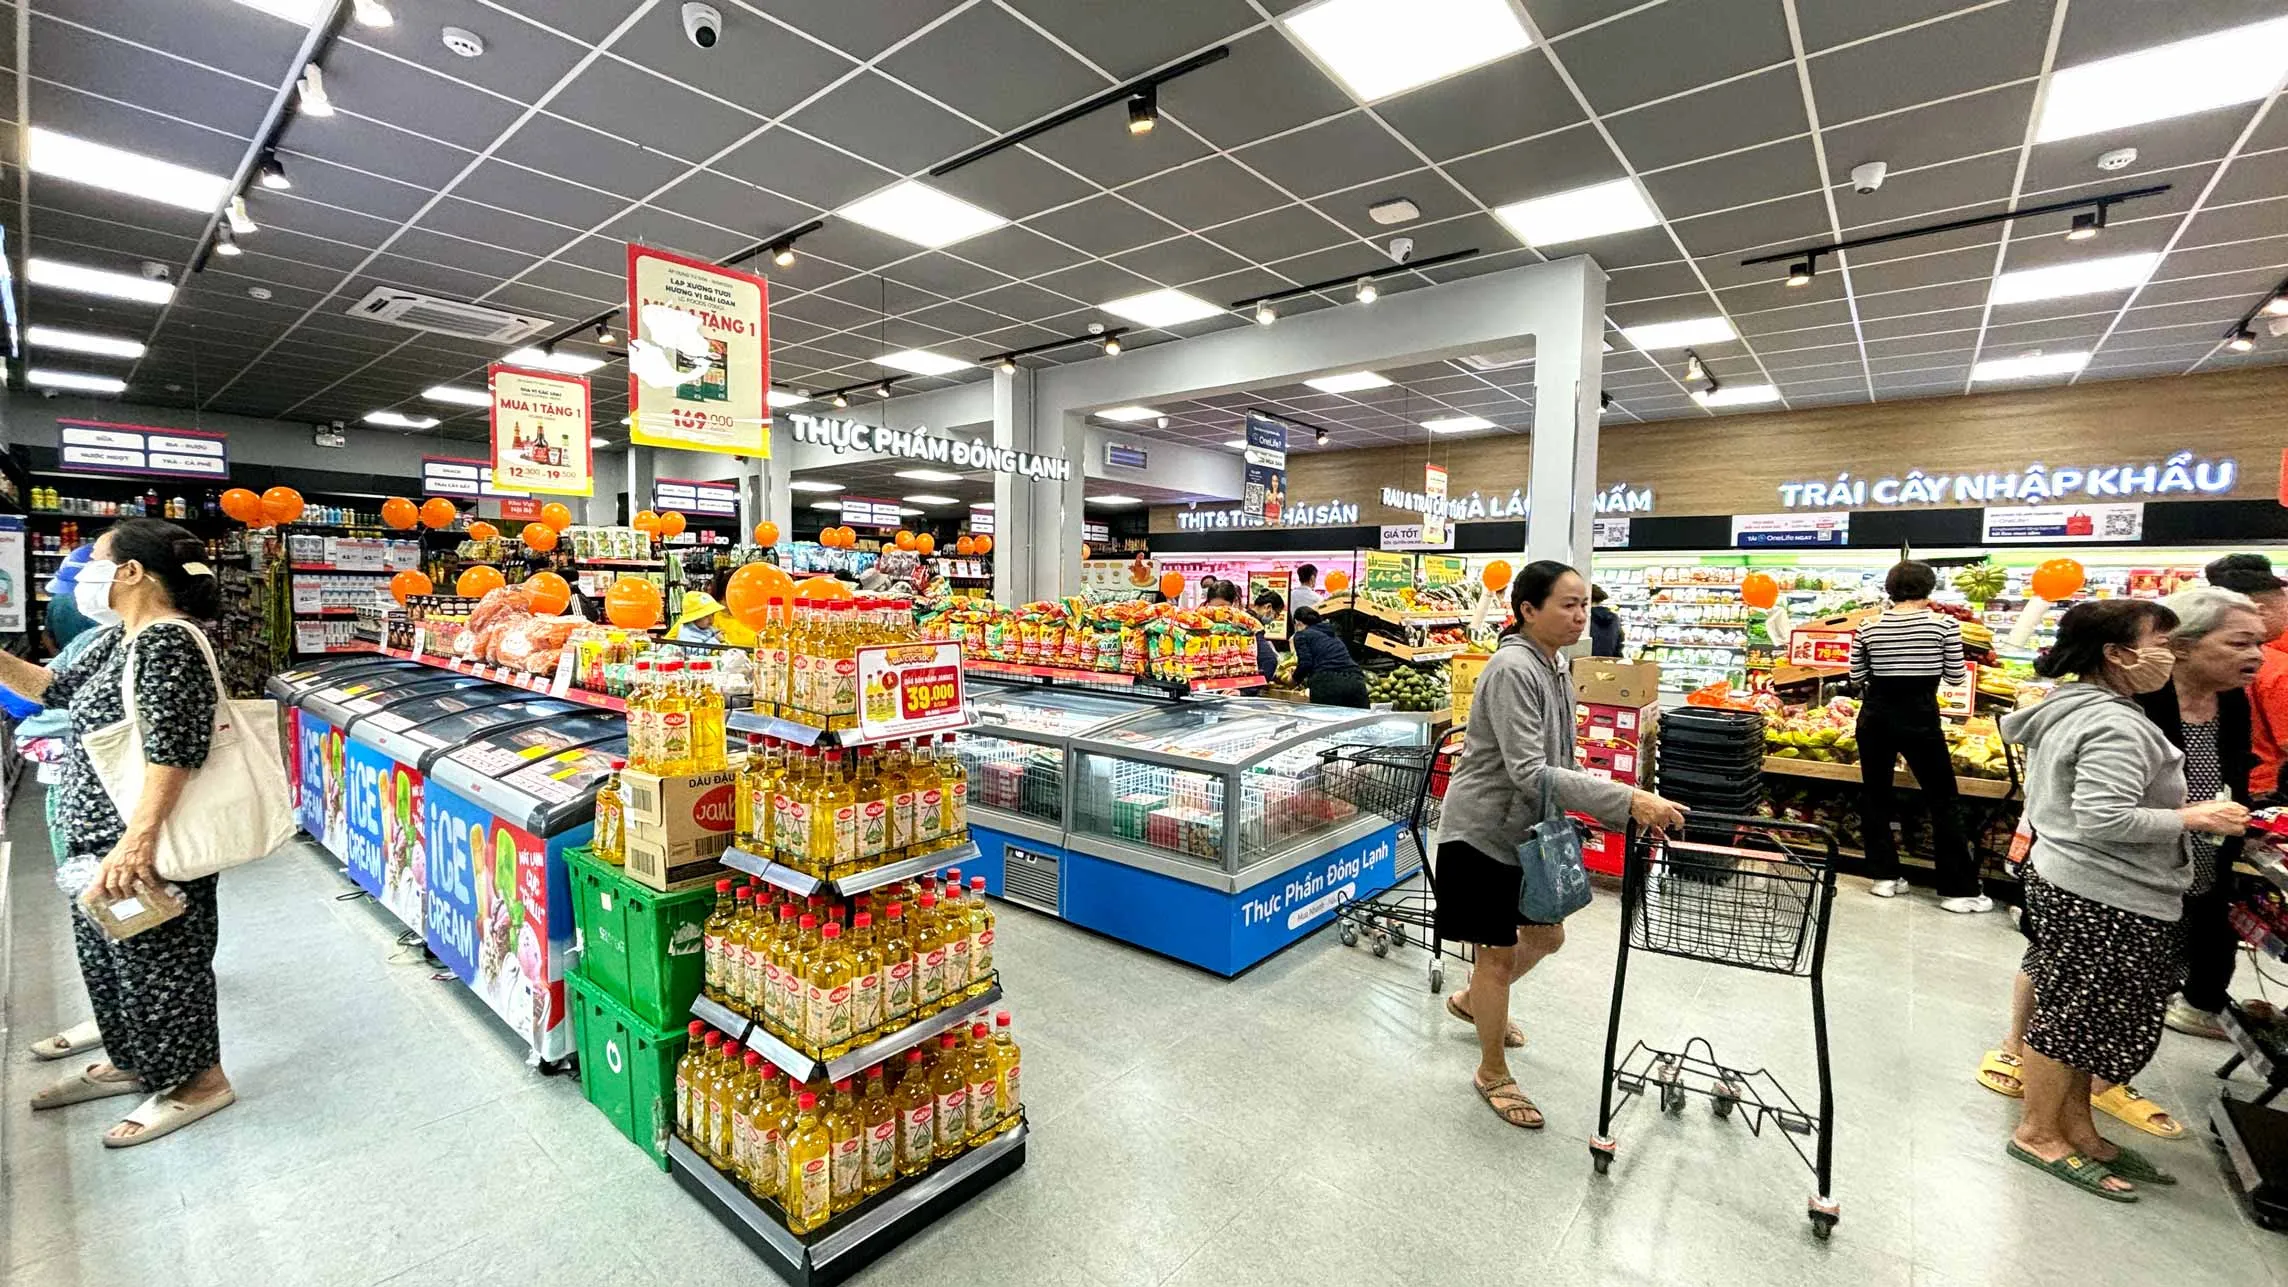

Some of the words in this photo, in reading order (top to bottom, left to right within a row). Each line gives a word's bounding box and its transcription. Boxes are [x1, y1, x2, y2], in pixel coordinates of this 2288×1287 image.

[700, 310, 745, 334] TẶNG
[749, 322, 755, 336] 1
[500, 399, 529, 411] MUA
[533, 403, 538, 412] 1
[540, 403, 573, 416] TẶNG
[576, 409, 581, 418] 1
[788, 412, 872, 453] THỰC
[873, 425, 950, 463] PHẨM
[950, 438, 1016, 474] ĐÔNG
[1016, 451, 1073, 482] LẠNH
[1382, 487, 1404, 508] RAU
[1778, 472, 1865, 508] TRÁI
[1872, 471, 1950, 505] CÂY
[1953, 463, 2084, 504] NHẬP
[2086, 452, 2236, 496] KHẨU
[1177, 510, 1216, 532] THỊT
[1315, 498, 1360, 525] SẢN
[1400, 528, 1418, 538] TỐT
[906, 683, 955, 711] 39.000
[351, 757, 379, 836] ICE
[713, 771, 735, 788] ĐẬU
[349, 828, 381, 884] CREAM
[430, 802, 470, 904] ICE
[1242, 895, 1281, 928] Thực
[1285, 871, 1324, 907] Phẩm
[1326, 857, 1360, 886] Đông
[1362, 840, 1389, 870] Lạnh
[428, 890, 473, 966] CREAM
